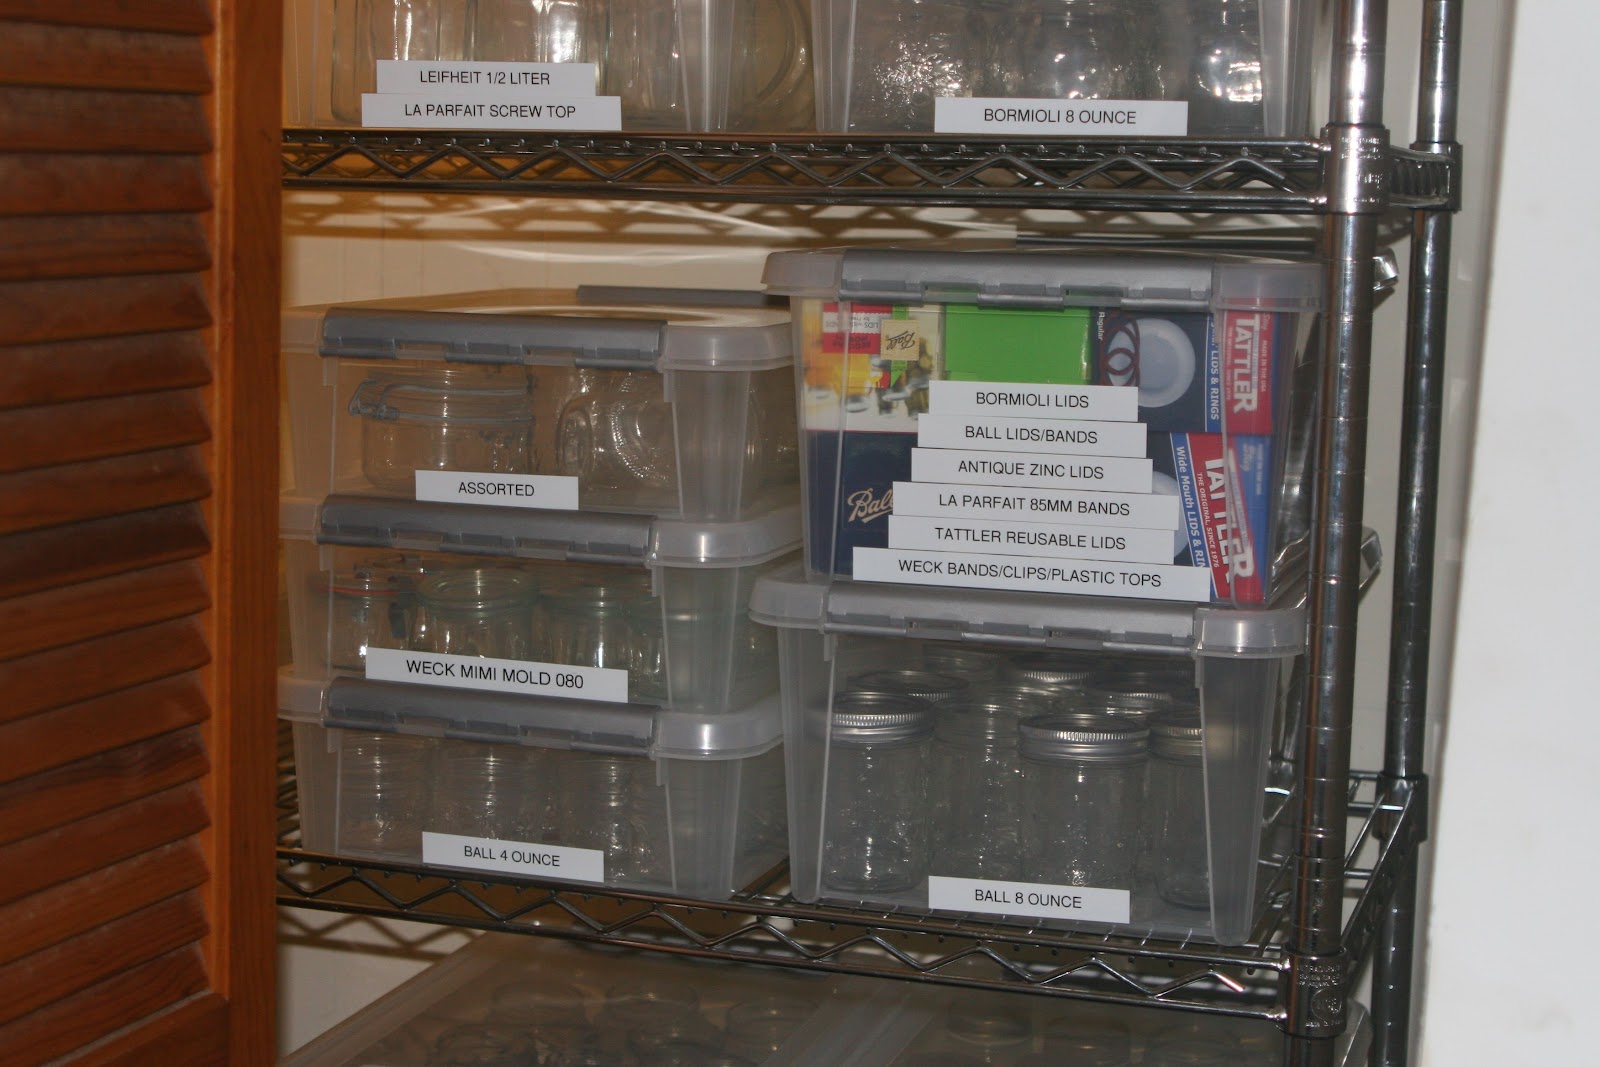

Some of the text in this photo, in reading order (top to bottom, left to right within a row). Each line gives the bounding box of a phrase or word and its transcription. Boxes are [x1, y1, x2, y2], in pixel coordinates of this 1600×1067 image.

[419, 70, 550, 85] LEIFHEIT 1/2 LITER
[404, 103, 576, 119] LA PARFAIT SCREW TOP
[984, 108, 1137, 125] BORMIOLI 8 OUNCE
[1096, 311, 1106, 341] Regular
[885, 330, 916, 351] Ball
[1211, 350, 1219, 375] LIDS
[1233, 313, 1260, 414] TATTLER
[1211, 377, 1219, 385] &
[975, 391, 1090, 409] BORMIOLI LIDS
[1210, 387, 1220, 420] RINGS
[965, 425, 1098, 445] BALL LIDS/BANDS
[957, 460, 1104, 480] ANTIQUE ZINC LIDS
[457, 481, 536, 497] ASSORTED
[939, 493, 1130, 516] LA PARFAIT 85MM BANDS
[1176, 446, 1206, 568] Wide Mouth LIDS & RIN
[1200, 486, 1211, 526] ORIGINAL,
[1205, 448, 1254, 584] TATTLER
[935, 527, 1126, 551] TATTLER REUSABLE LIDS
[1207, 527, 1216, 549] SINCE
[1211, 551, 1220, 568] 1976
[898, 559, 1162, 588] WECK BANDS/CLIPS/PLASTIC TOPS
[405, 659, 584, 689] WECK MIMI MOLD 080
[463, 845, 561, 867] BALL 4 OUNCE
[974, 888, 1082, 909] BALL 8 OUNCE
